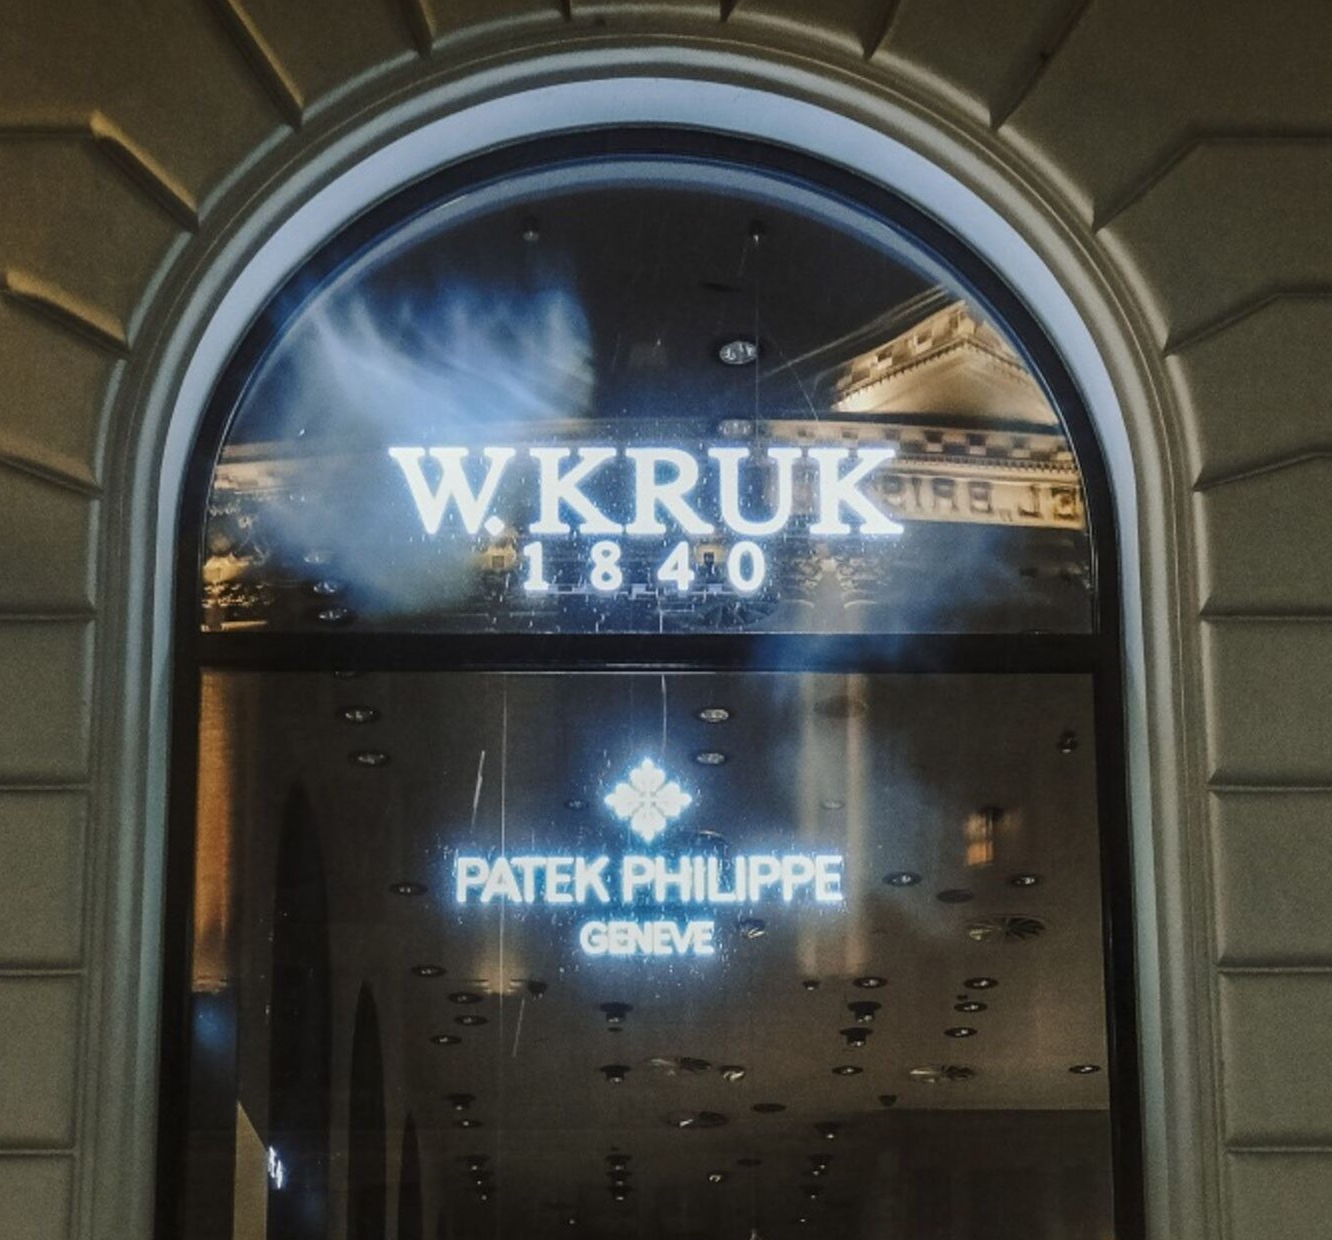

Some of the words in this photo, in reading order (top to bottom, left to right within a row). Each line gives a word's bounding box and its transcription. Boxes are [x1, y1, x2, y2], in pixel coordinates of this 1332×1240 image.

[524, 542, 766, 591] 1840
[456, 856, 610, 902] PATEK
[622, 856, 844, 902] PHILIPPE
[579, 921, 715, 955] GENEVE
